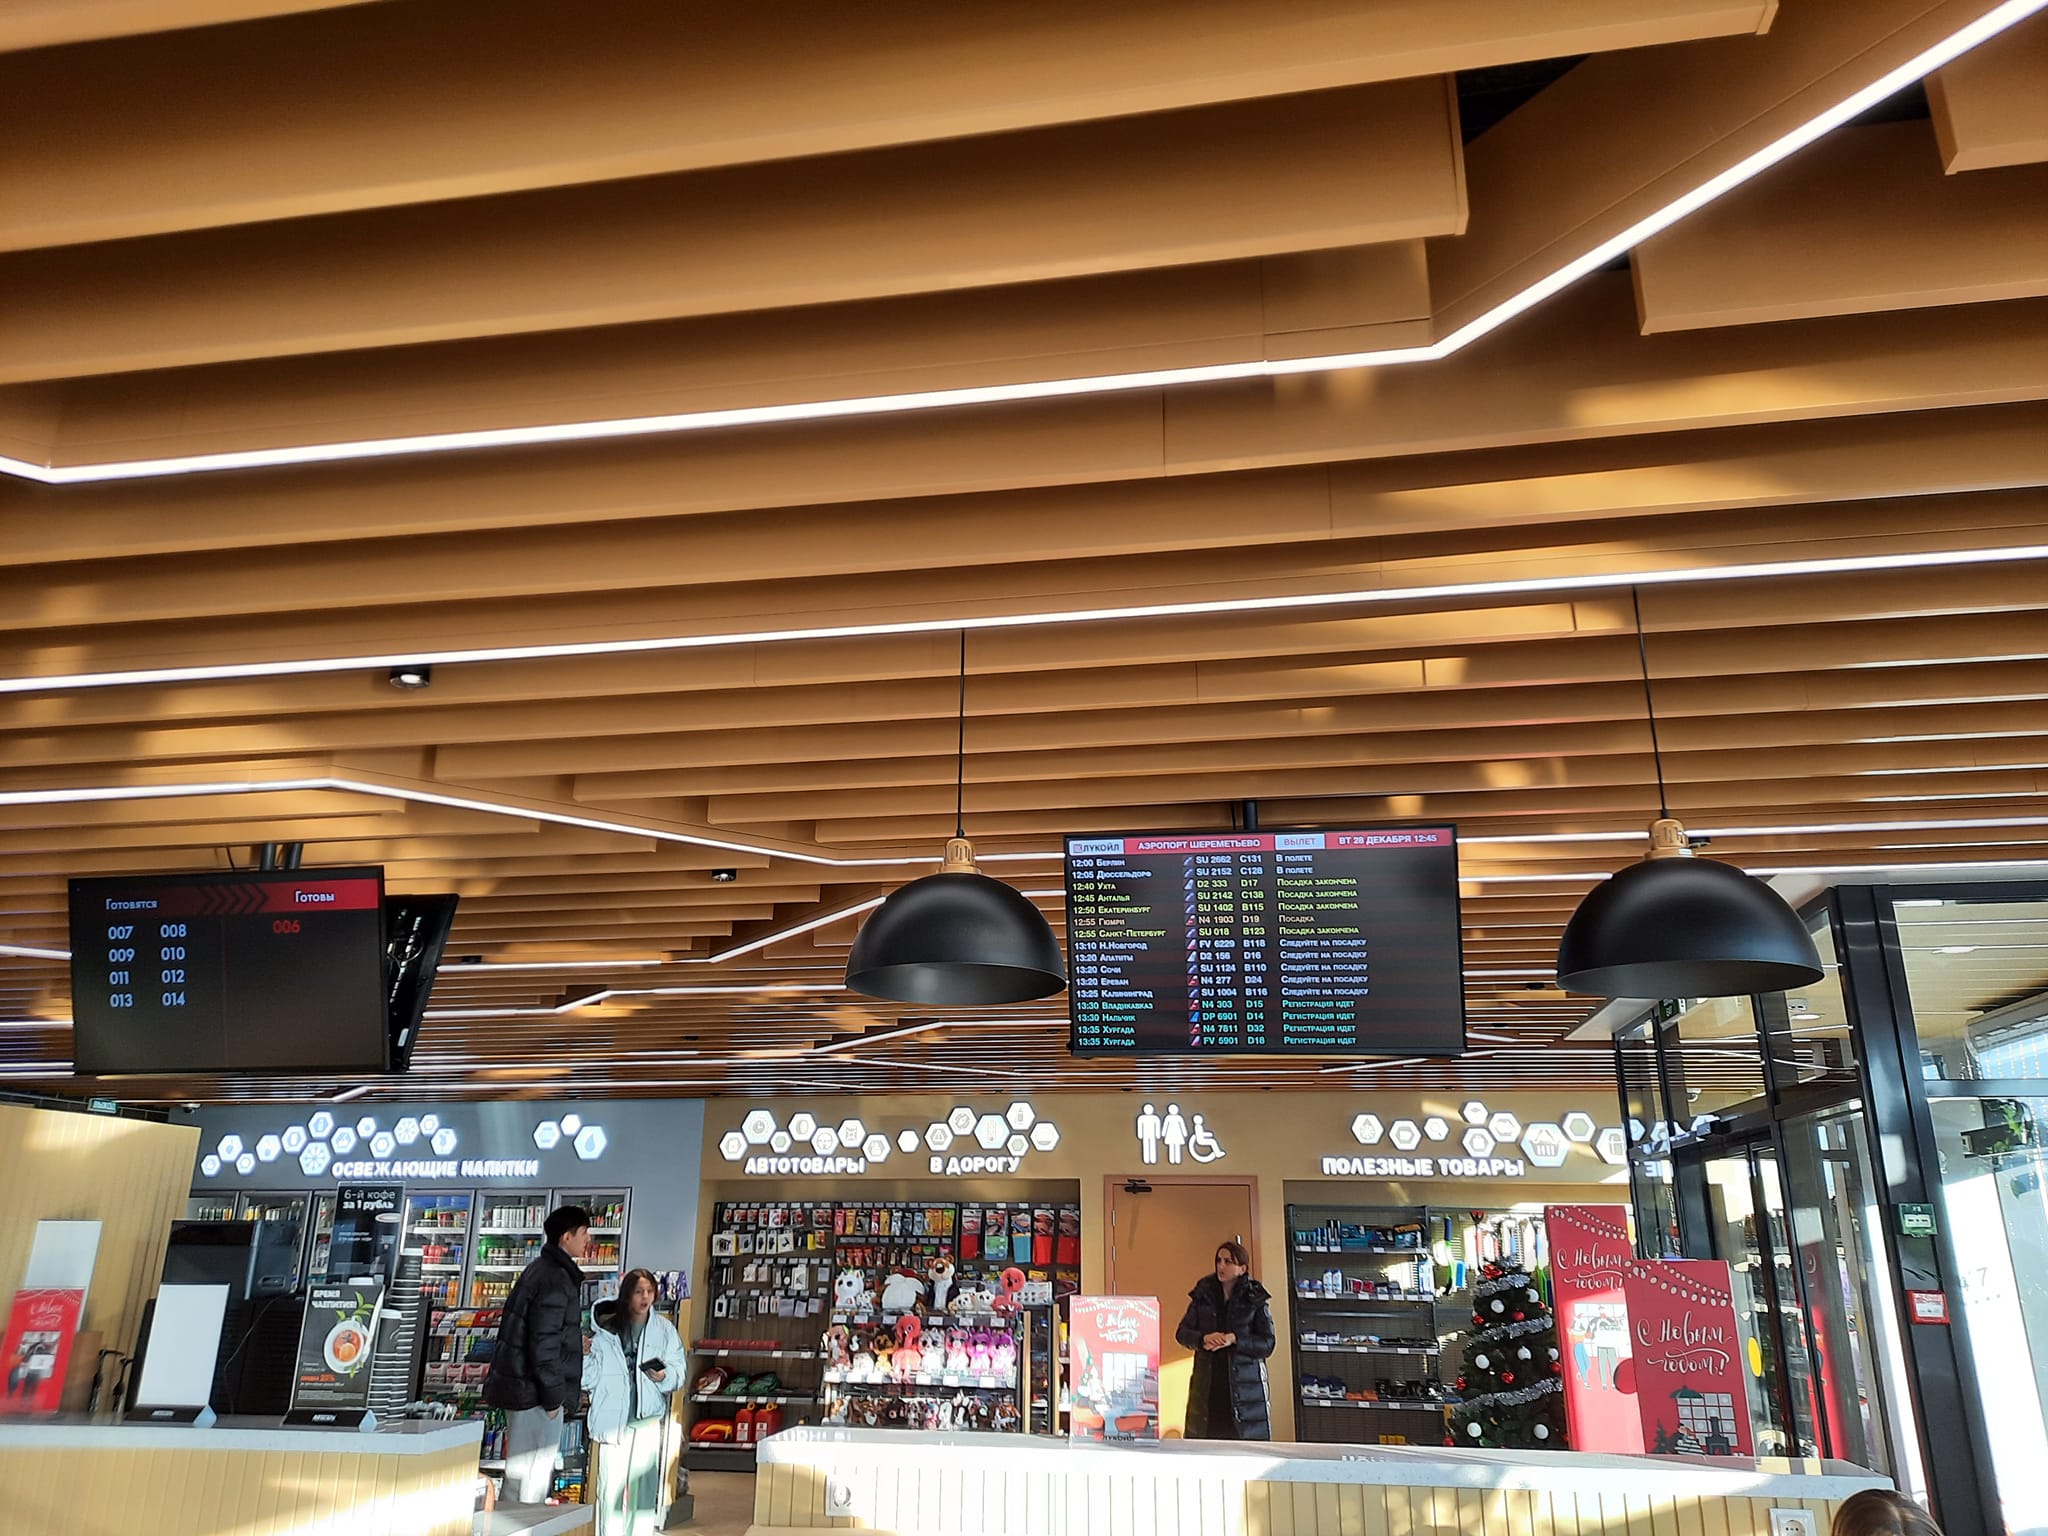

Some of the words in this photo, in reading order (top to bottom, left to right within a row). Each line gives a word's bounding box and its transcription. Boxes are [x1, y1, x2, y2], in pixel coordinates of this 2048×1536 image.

[1138, 841, 1187, 850] АЭРОПОРТ
[1190, 839, 1260, 849] ШЕРЕМЕТЬЕВО
[1284, 838, 1316, 846] ВЫЛЕТ
[1339, 836, 1352, 845] ВТ
[1366, 835, 1411, 845] ДЕКАБРЯ
[1414, 834, 1437, 842] 12:45
[1083, 843, 1120, 852] ЛУКОЙЛ
[1196, 856, 1208, 864] SU
[1276, 854, 1284, 862] В
[1196, 868, 1209, 876] SU
[1211, 868, 1232, 876] 2152
[1240, 867, 1263, 875] C128
[1276, 866, 1284, 874] В
[1197, 880, 1209, 888] D2
[1212, 880, 1228, 888] 333
[295, 891, 335, 903] Готовы
[1198, 892, 1210, 900] SU
[1212, 892, 1233, 900] 2142
[106, 898, 158, 910] Готовятся
[1073, 906, 1095, 914] 12:50
[1198, 904, 1210, 912] SU
[1214, 904, 1234, 912] 1402
[1242, 902, 1264, 910] B115
[1074, 918, 1096, 926] 12:55
[1198, 916, 1210, 924] N4
[108, 926, 134, 940] 007
[160, 924, 187, 938] 008
[272, 920, 300, 934] 006
[1074, 930, 1096, 938] 12:55
[1199, 928, 1212, 936] SU
[1214, 928, 1230, 936] 018
[1242, 927, 1265, 935] B123
[1074, 942, 1096, 950] 13:10
[1200, 940, 1212, 948] FV
[1244, 940, 1266, 948] B118
[108, 948, 135, 962] 009
[160, 946, 186, 960] 010
[1075, 954, 1097, 962] 13:20
[1200, 952, 1212, 960] D2
[1076, 966, 1097, 974] 13:20
[1200, 964, 1213, 972] SU
[1216, 964, 1236, 972] 1124
[1244, 964, 1266, 972] B110
[109, 971, 129, 985] 011
[161, 970, 185, 984] 012
[1076, 978, 1098, 986] 13:20
[1200, 976, 1213, 984] N4
[1216, 976, 1232, 984] 277
[1245, 976, 1262, 984] D24
[1076, 990, 1098, 998] 13:25
[1202, 988, 1214, 996] SU
[1217, 988, 1237, 996] 1004
[1246, 988, 1268, 996] B116
[110, 994, 134, 1008] 013
[162, 992, 186, 1006] 014
[1077, 1002, 1098, 1010] 13:30
[1202, 1000, 1214, 1008] N4
[1216, 1000, 1232, 1008] 303
[1246, 1000, 1264, 1008] D15
[1078, 1014, 1100, 1022] 13:30
[1203, 1012, 1216, 1020] DP
[1246, 1012, 1264, 1020] D14
[1078, 1026, 1100, 1034] 13:35
[1203, 1024, 1215, 1032] N4
[1247, 1024, 1264, 1032] D32
[1078, 1038, 1100, 1046] 13:35
[1204, 1036, 1215, 1045] FV
[331, 1160, 457, 1179] ОСВЕЖАЮЩИЕ
[460, 1160, 540, 1177] НАПИТКИ
[744, 1156, 866, 1174] АВТОТОВАРЫ
[929, 1156, 943, 1173] В
[945, 1156, 1020, 1176] ДОРОГУ
[1322, 1157, 1434, 1176] ПОЛЕЗНЫЕ
[1438, 1158, 1525, 1177] ТОВАРЫ
[344, 1188, 364, 1200] 6-й
[366, 1190, 396, 1200] кофе
[343, 1201, 355, 1209] за
[356, 1200, 362, 1209] 1
[362, 1200, 394, 1211] рубль
[1556, 1248, 1568, 1269] С
[1573, 1242, 1622, 1270] Новым
[1637, 1318, 1654, 1347] С
[1658, 1311, 1732, 1347] Новым
[1647, 1348, 1731, 1376] годом!
